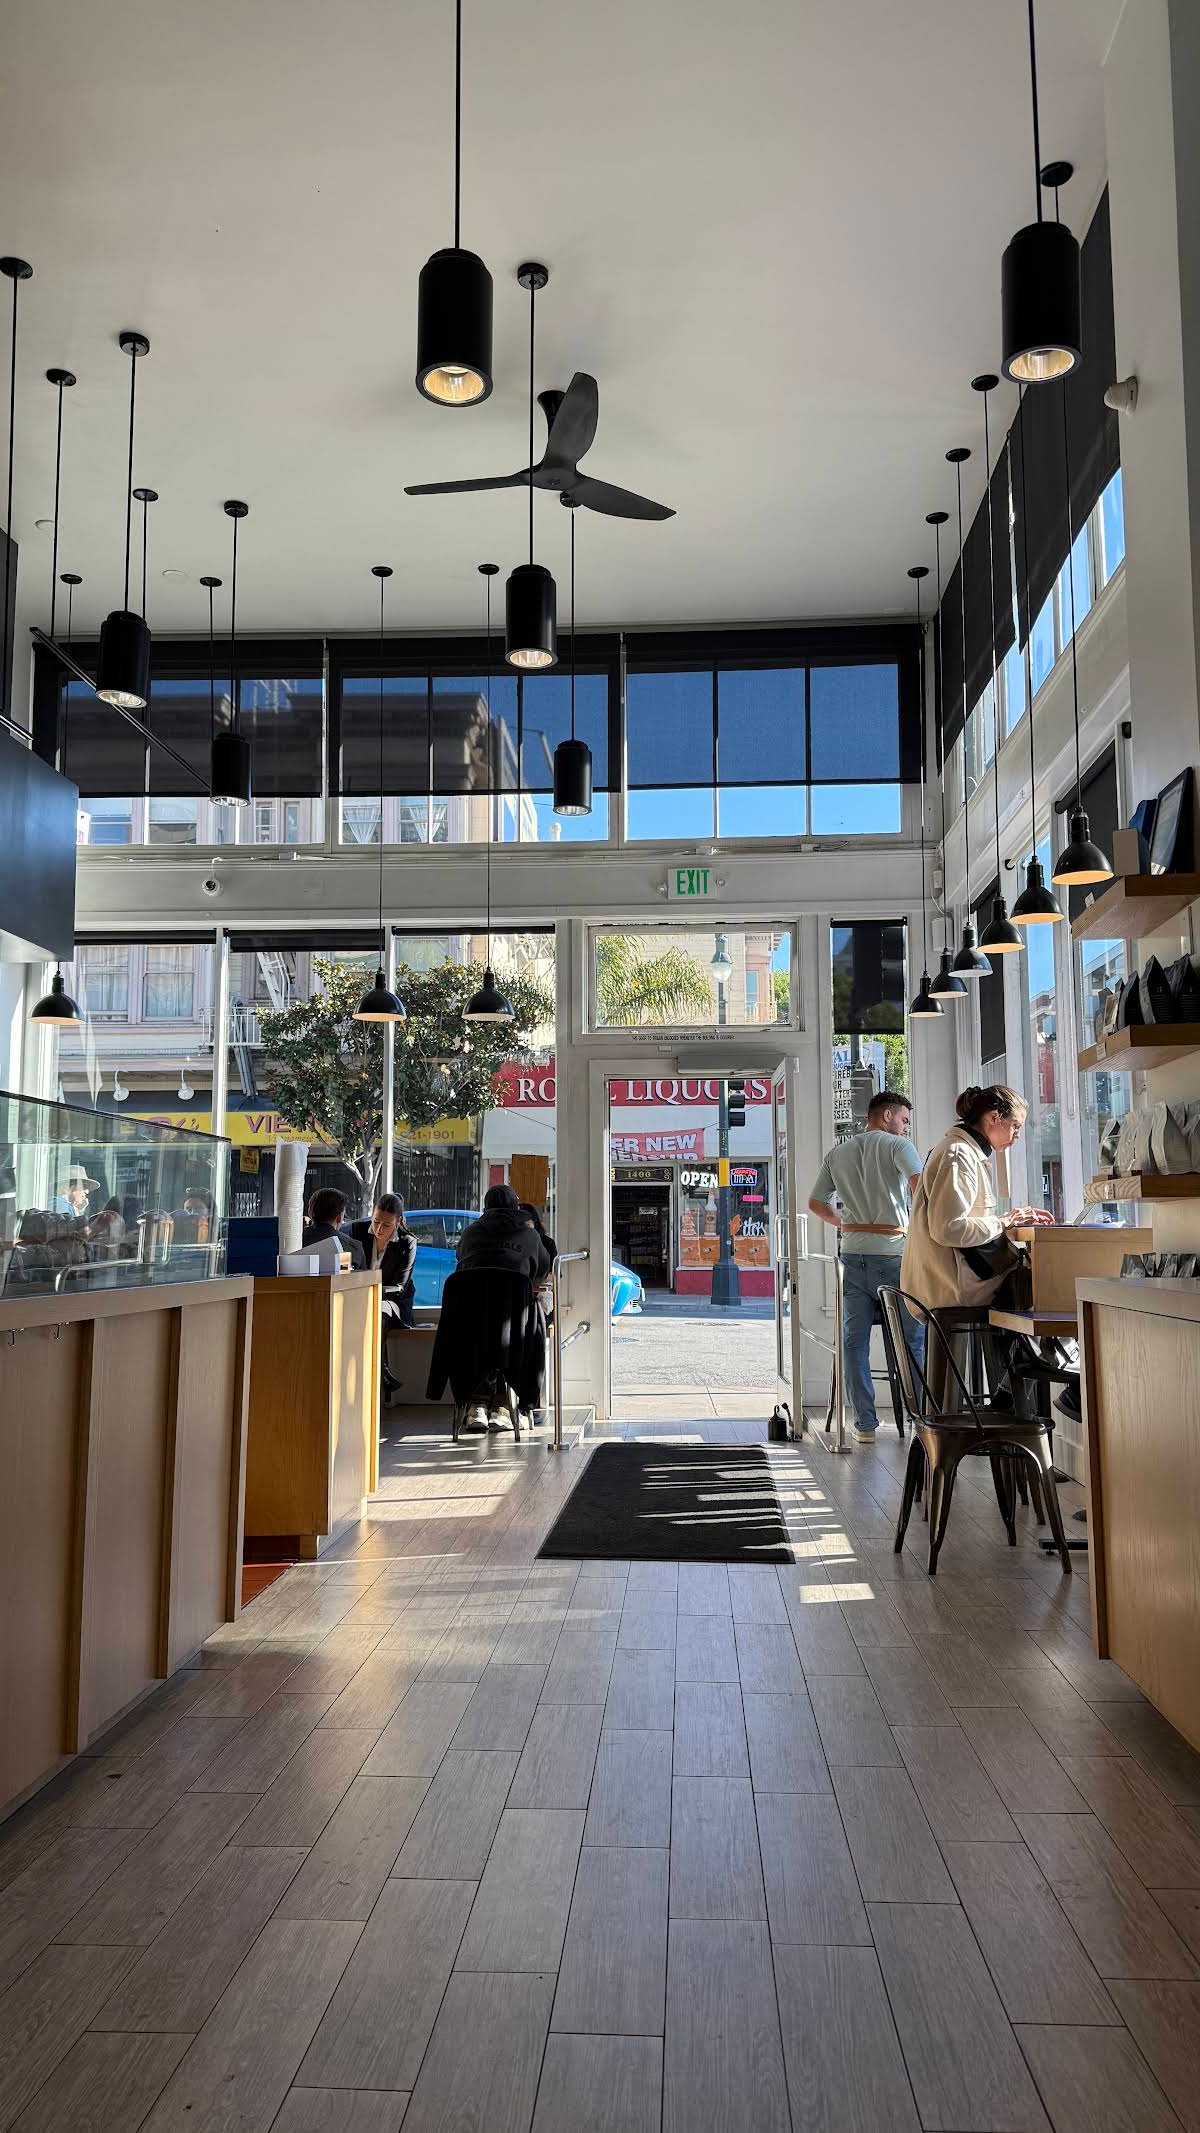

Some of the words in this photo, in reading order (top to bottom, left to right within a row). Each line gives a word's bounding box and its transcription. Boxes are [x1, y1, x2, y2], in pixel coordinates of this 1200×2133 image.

[676, 868, 710, 896] EXIT
[626, 1080, 767, 1105] LIQUOS
[645, 1133, 697, 1152] NEW
[627, 1170, 652, 1179] 1400
[680, 1171, 719, 1188] OPEN
